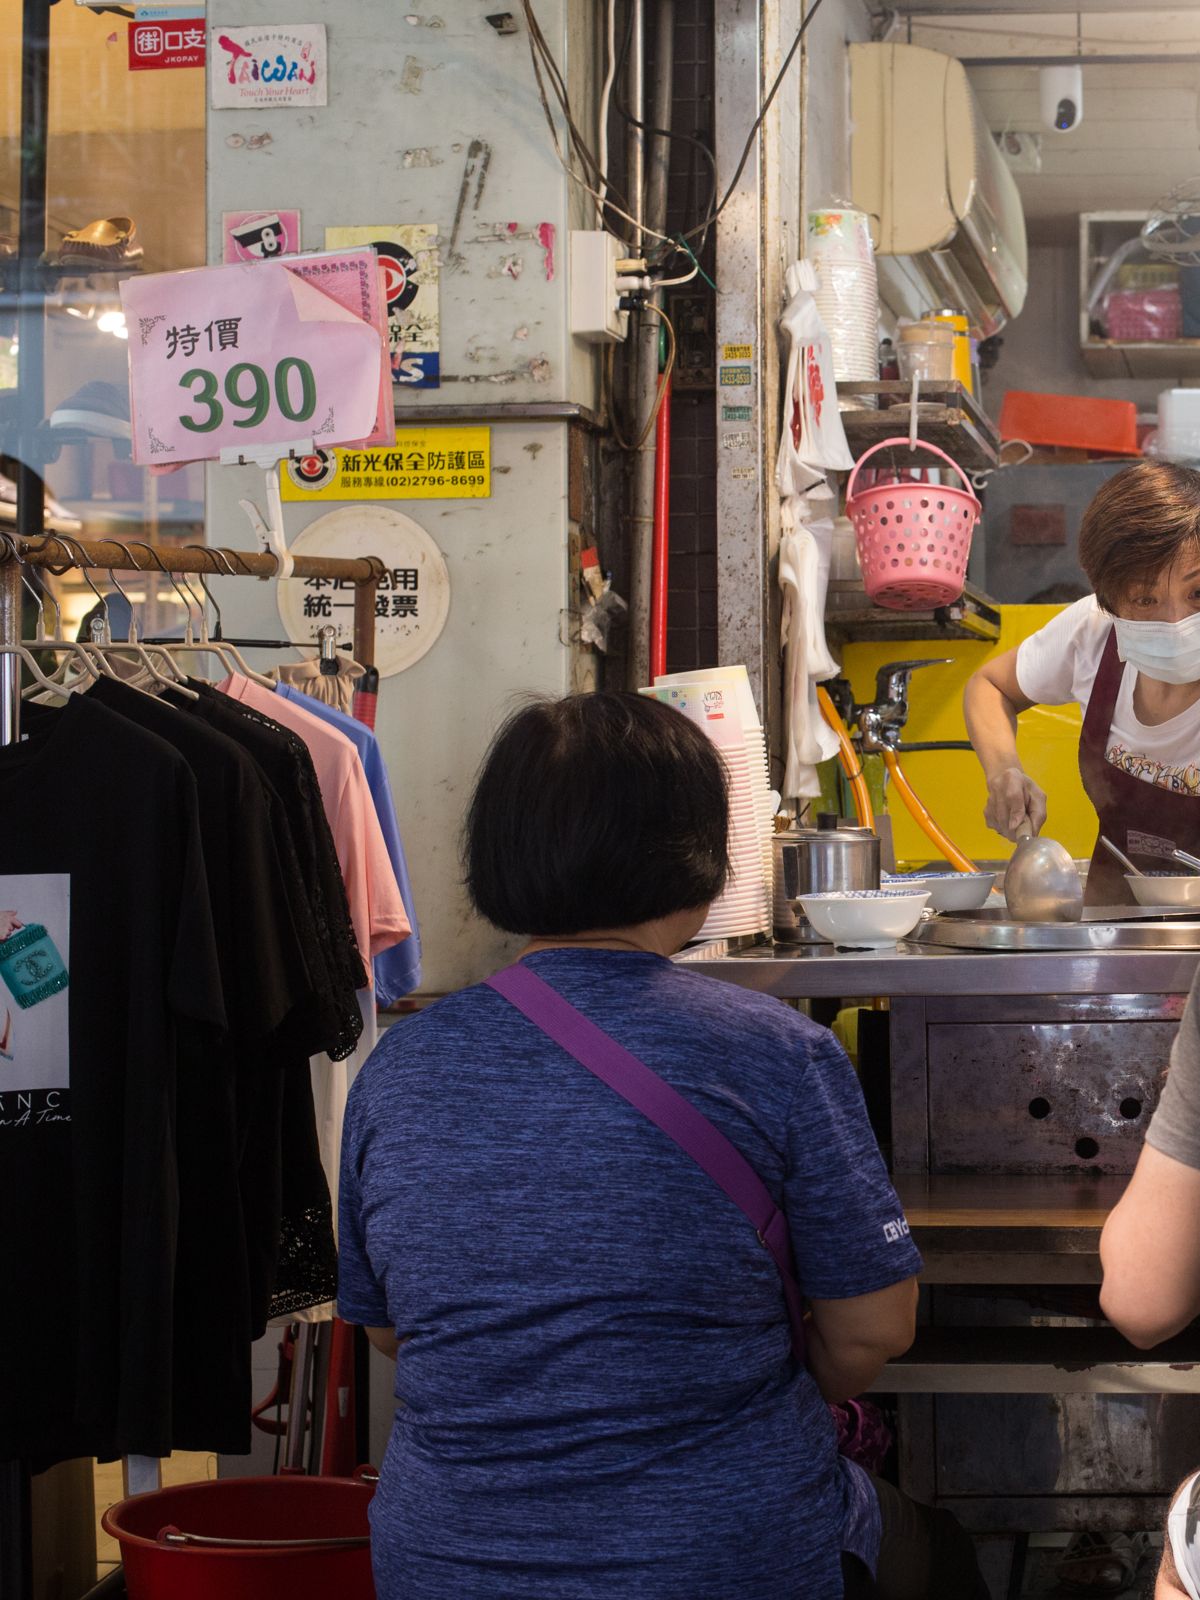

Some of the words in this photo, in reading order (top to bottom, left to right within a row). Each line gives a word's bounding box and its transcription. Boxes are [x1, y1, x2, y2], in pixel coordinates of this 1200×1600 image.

[137, 27, 205, 53] 街口支
[164, 55, 199, 63] JKOPAY
[240, 88, 263, 97] Touch
[264, 87, 285, 97] Your
[286, 87, 309, 96] Heart
[166, 317, 242, 359] 特價
[178, 357, 316, 433] 390
[342, 451, 485, 472] 新光保全防護區
[36, 1108, 72, 1124] Time
